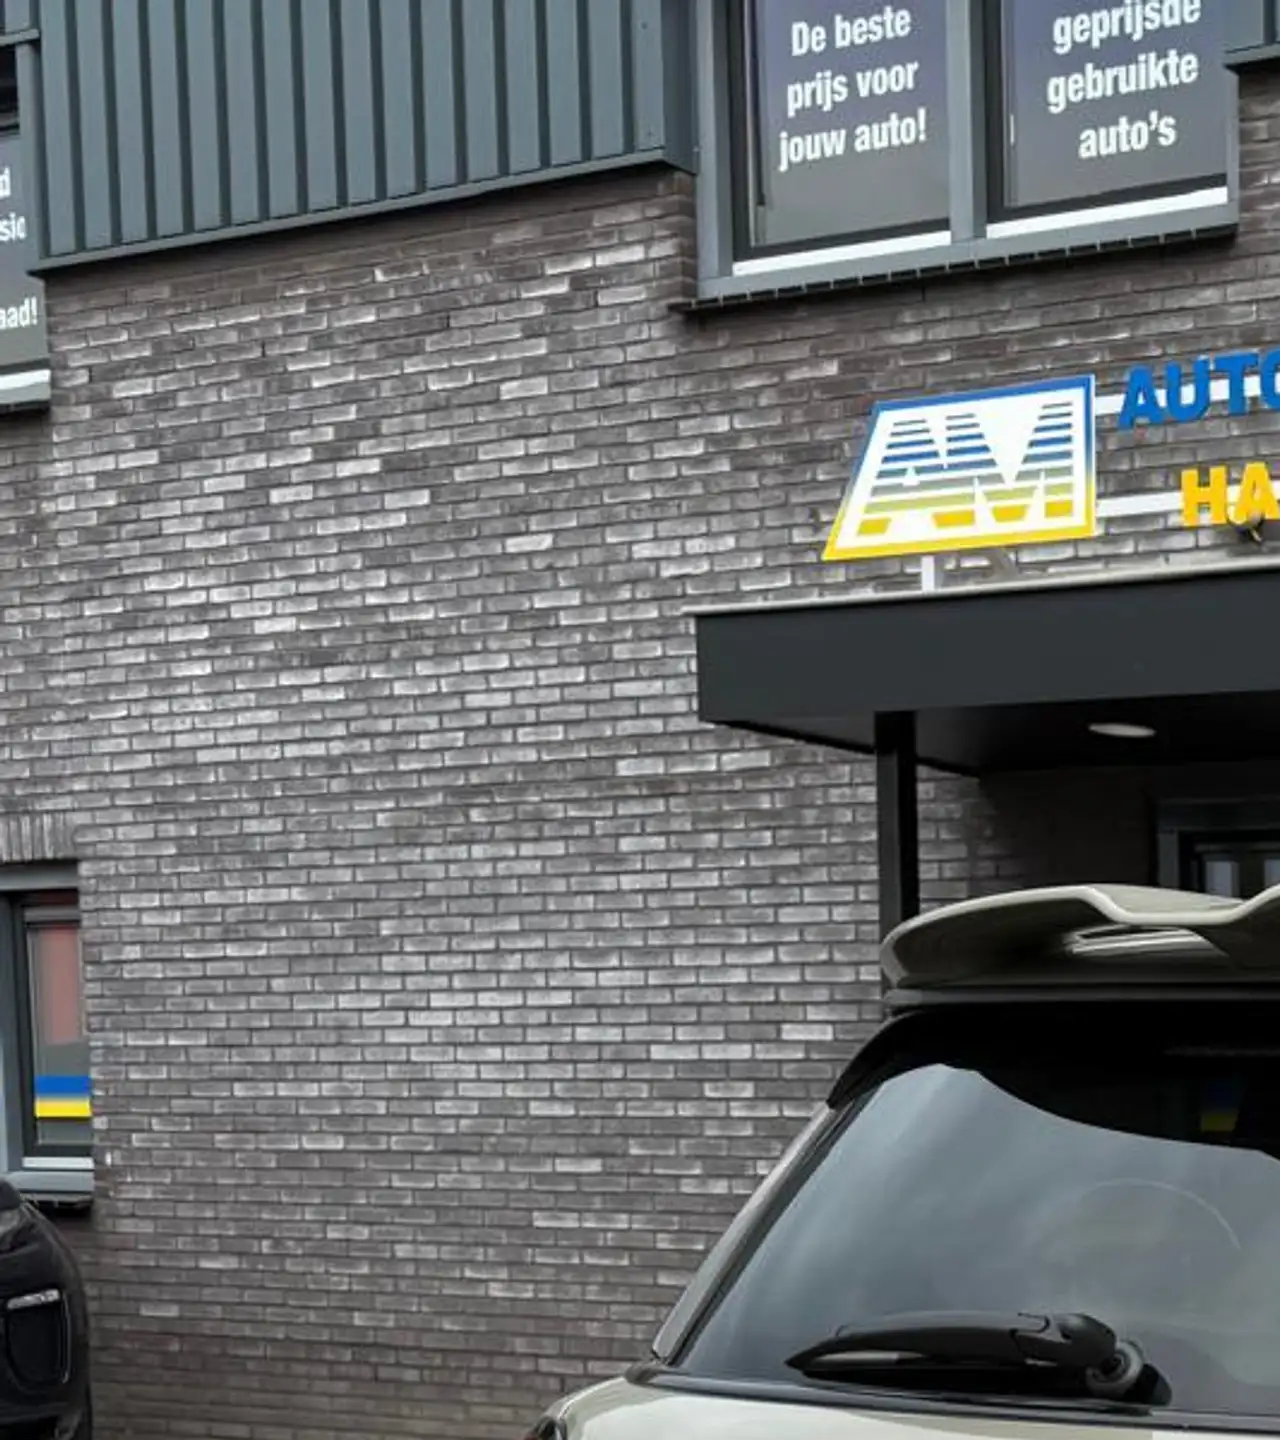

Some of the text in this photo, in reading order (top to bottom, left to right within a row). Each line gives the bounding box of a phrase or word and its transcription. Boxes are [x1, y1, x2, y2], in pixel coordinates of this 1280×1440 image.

[792, 5, 911, 56] De beste
[1053, 0, 1201, 54] geprijsde
[787, 60, 920, 119] prijs voor
[1047, 48, 1199, 114] gebruikte
[778, 107, 927, 172] jouw auto!
[1079, 110, 1176, 159] auto's
